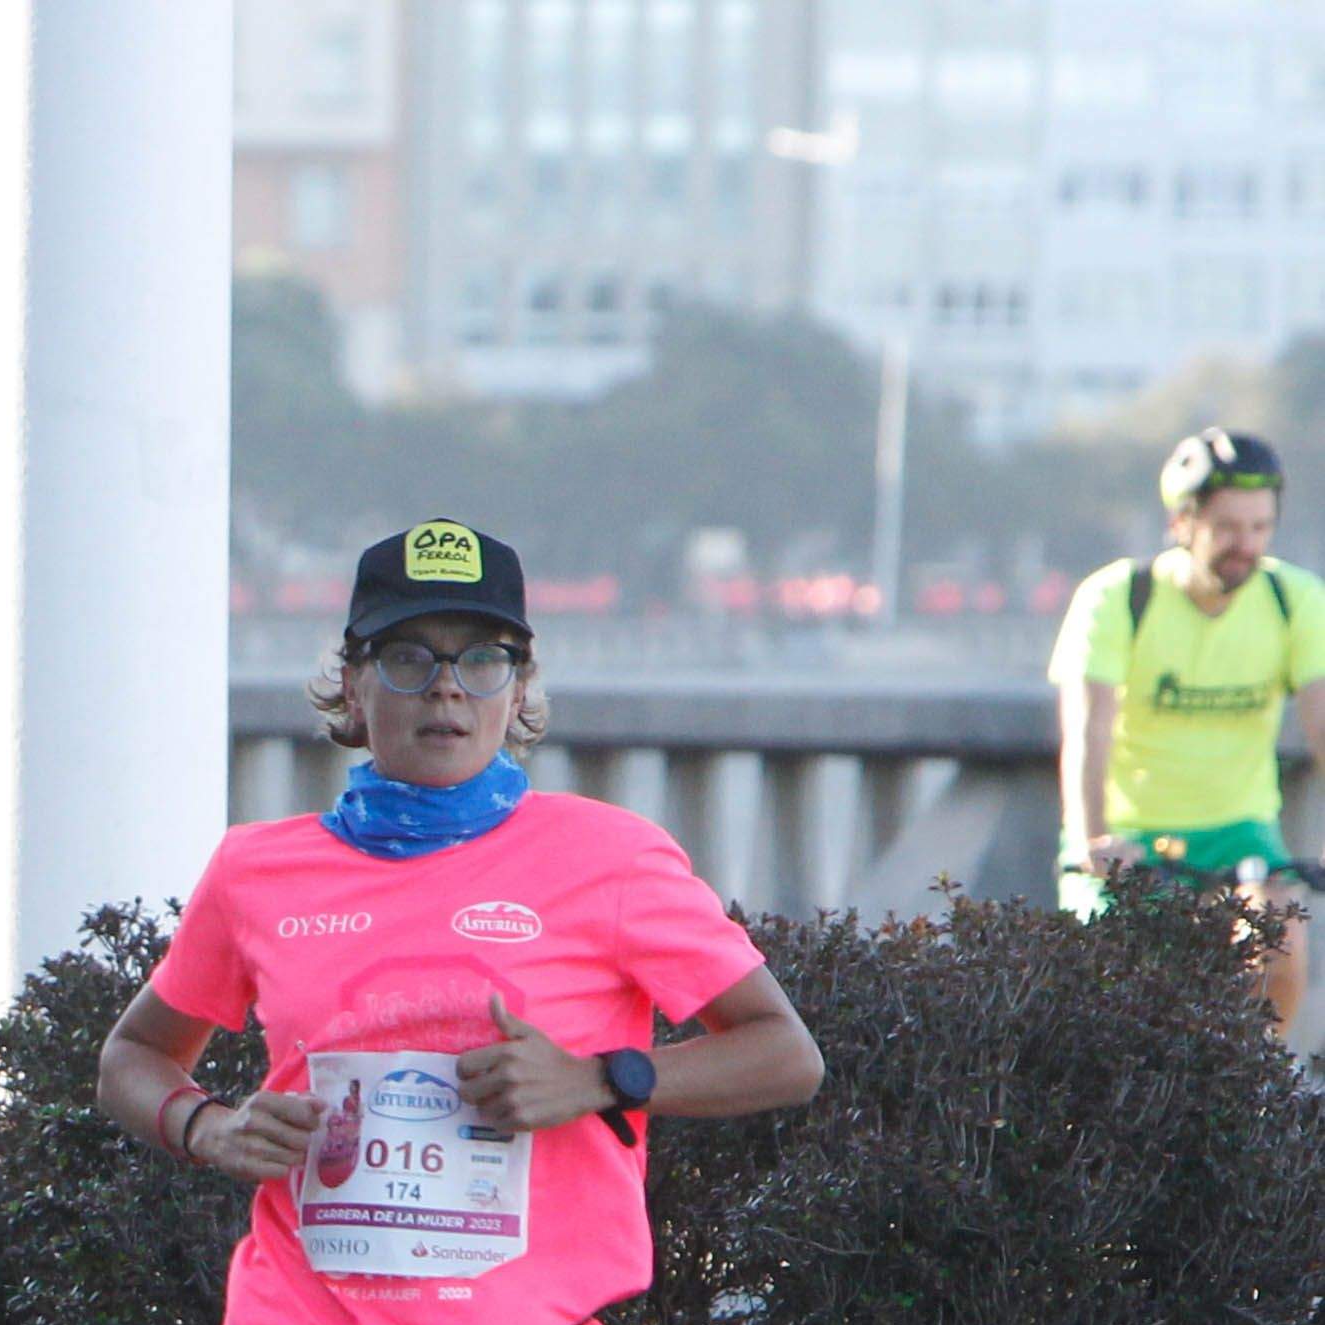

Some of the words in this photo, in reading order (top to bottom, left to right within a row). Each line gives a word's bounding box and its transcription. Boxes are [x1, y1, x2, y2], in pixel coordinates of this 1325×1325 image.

[414, 528, 472, 552] OPA
[417, 549, 470, 563] FERROL
[278, 912, 372, 938] OYSHO
[365, 1138, 444, 1173] 016
[384, 1181, 422, 1200] 174
[315, 1208, 371, 1222] CARRERA
[373, 1210, 393, 1223] DE
[396, 1212, 415, 1225] LA
[416, 1215, 465, 1229] MUJER
[430, 1245, 507, 1263] Santander
